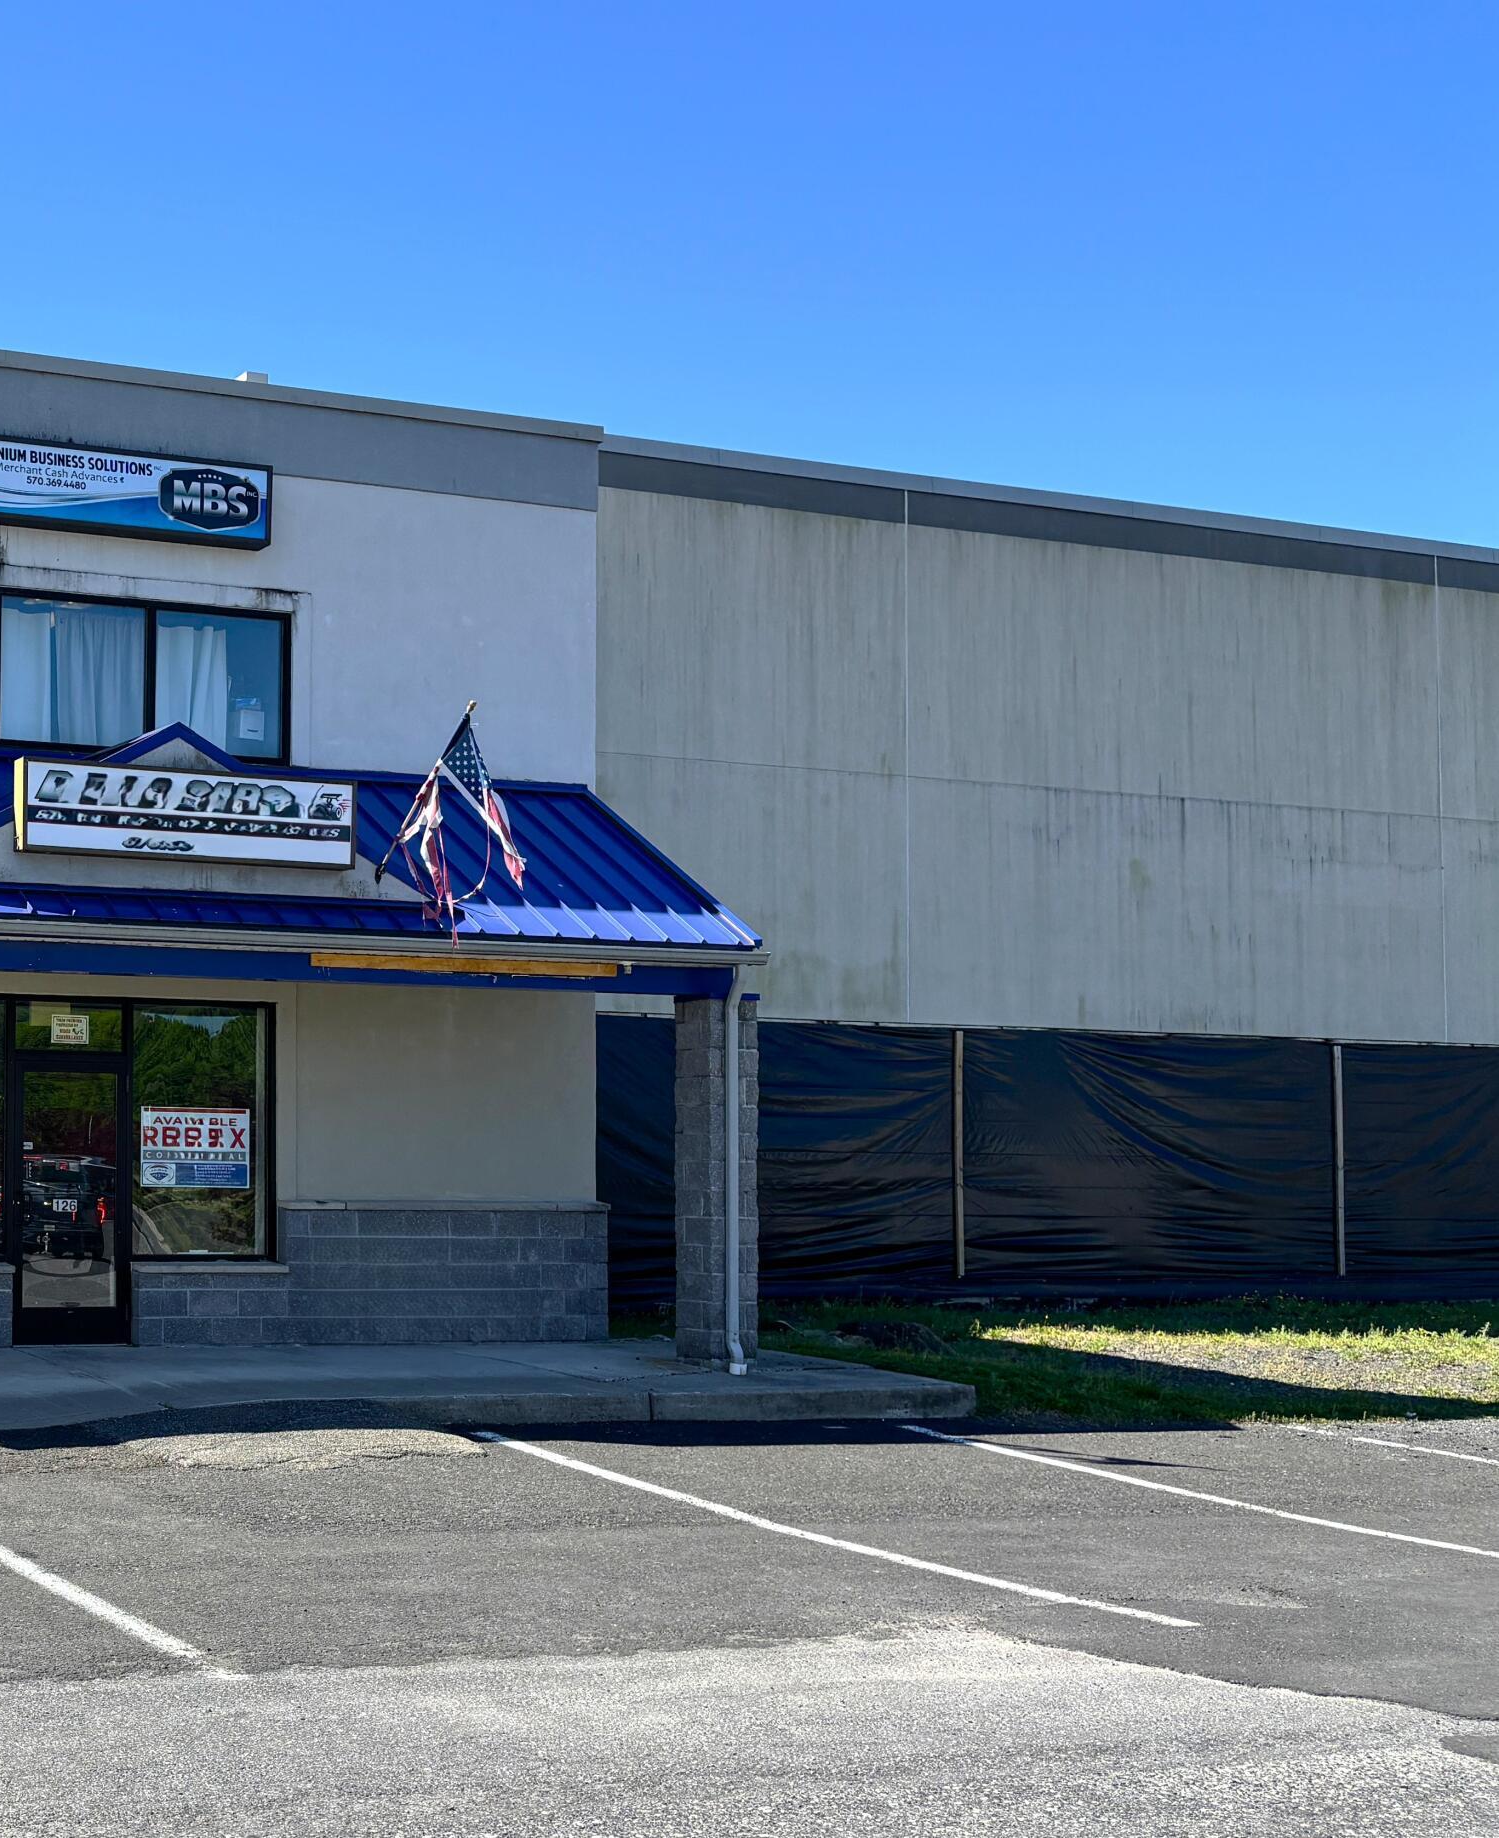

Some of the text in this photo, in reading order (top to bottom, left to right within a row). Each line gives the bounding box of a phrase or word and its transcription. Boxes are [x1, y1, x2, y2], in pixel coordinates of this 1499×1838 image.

[30, 450, 85, 469] BUSINESS
[88, 458, 153, 476] SOLUTIONS
[26, 476, 87, 490] 570.369.4480
[45, 467, 69, 479] Cash
[71, 471, 118, 484] Advances
[173, 479, 249, 520] MBS
[55, 1201, 77, 1212] 126
